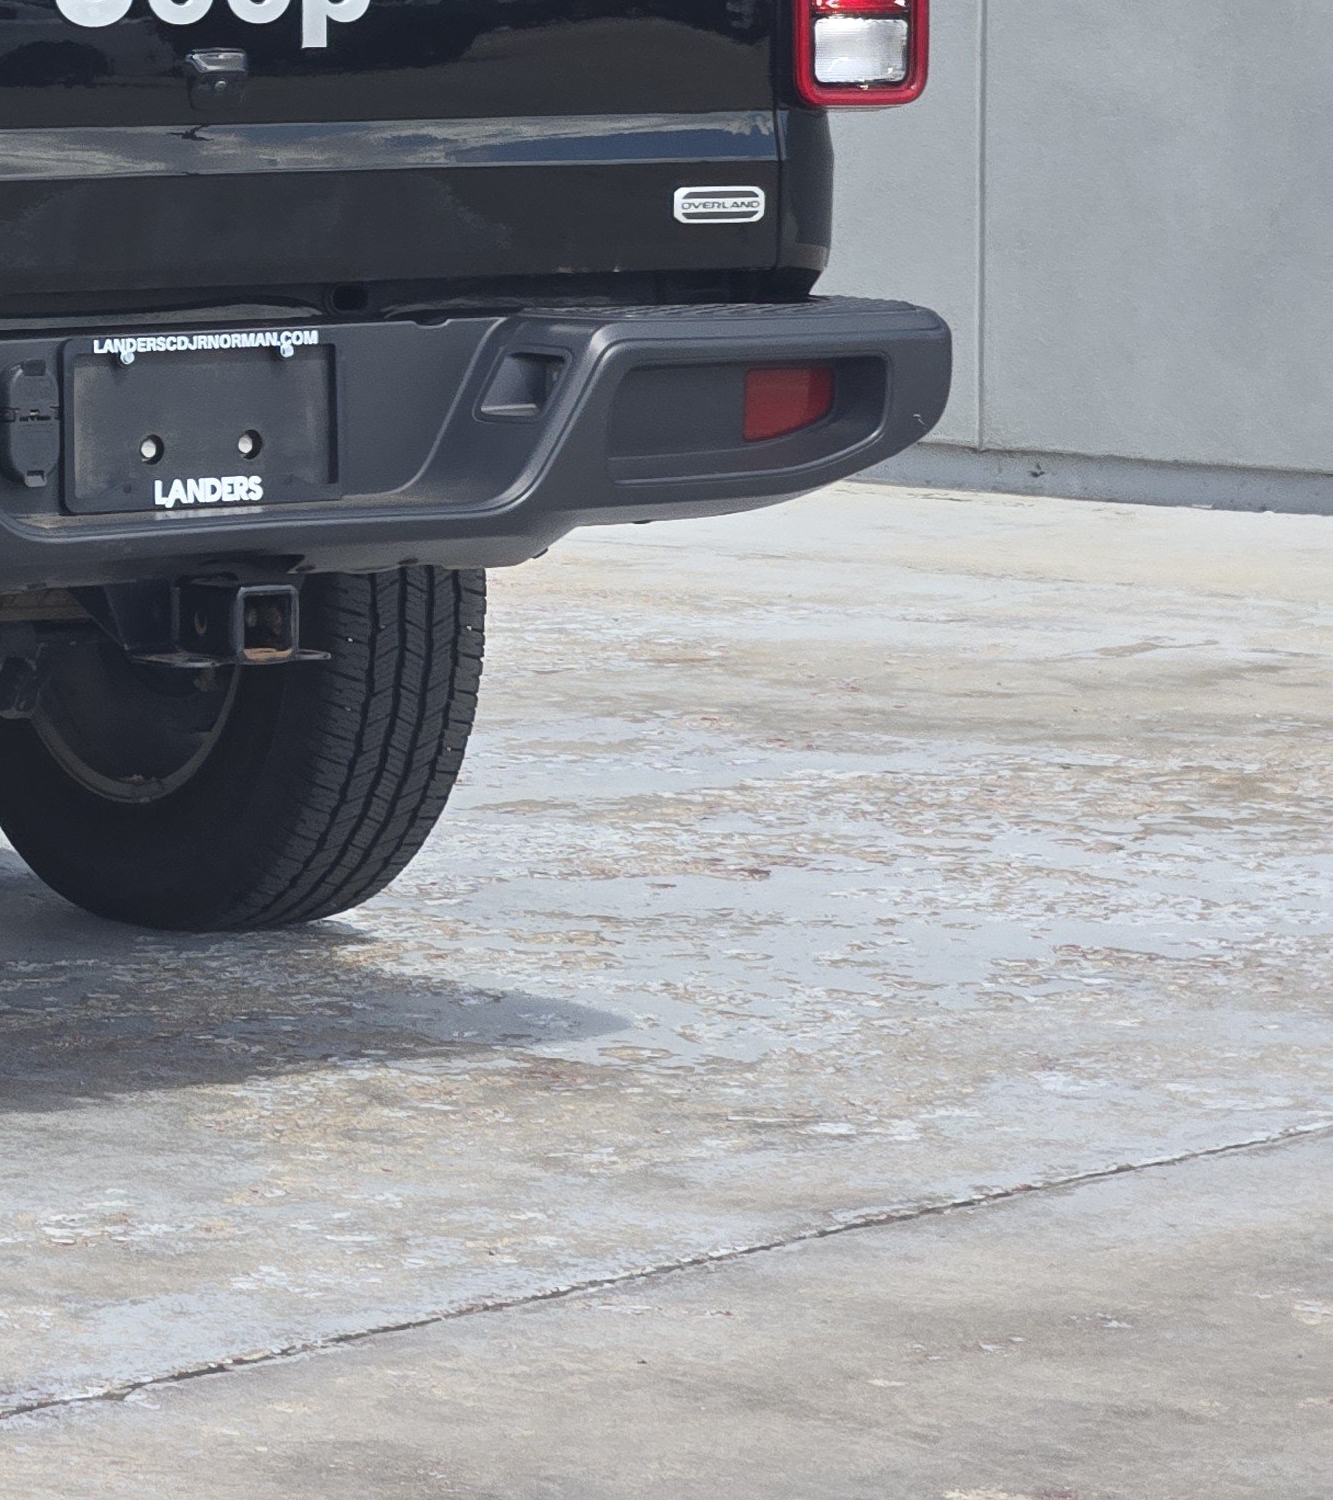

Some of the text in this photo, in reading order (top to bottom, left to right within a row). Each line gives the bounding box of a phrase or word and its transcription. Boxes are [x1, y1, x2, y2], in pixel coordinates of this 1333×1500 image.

[681, 200, 761, 210] OVERLAND
[93, 330, 319, 354] LANDERSCDJRNORMAN.COM
[154, 475, 264, 508] LANDERS
